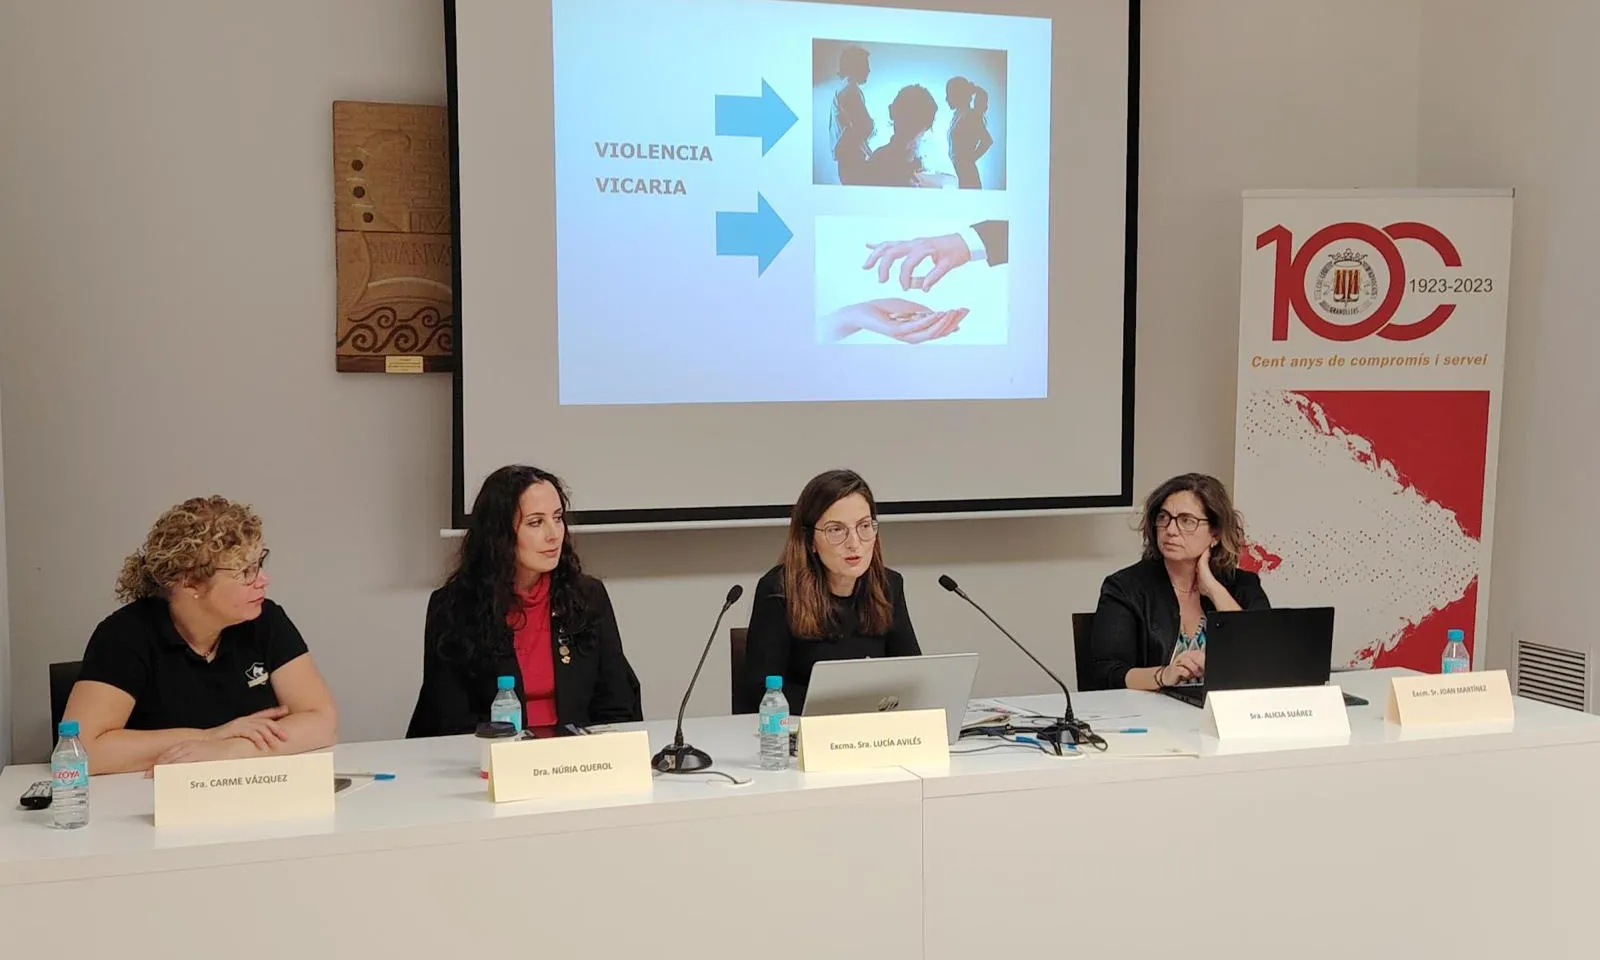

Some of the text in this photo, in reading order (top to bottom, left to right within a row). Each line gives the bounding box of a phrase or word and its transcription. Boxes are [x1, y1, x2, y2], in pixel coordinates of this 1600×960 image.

[594, 142, 713, 161] VIOLENCIA
[595, 177, 687, 195] VICARIA
[1409, 278, 1493, 293] 1923-2023
[1252, 352, 1488, 370] Cent anys de compromís i servei
[1456, 684, 1487, 694] MARTÍNEZ
[1264, 711, 1286, 719] ALICIA
[1286, 708, 1313, 718] SUÁREZ
[830, 736, 922, 750] Excma. Sra. LUCÍA AVILÉS
[533, 762, 613, 776] Dra. NÚRIA QUEROL
[190, 774, 288, 789] Sra. CARME VÁZQUEZ
